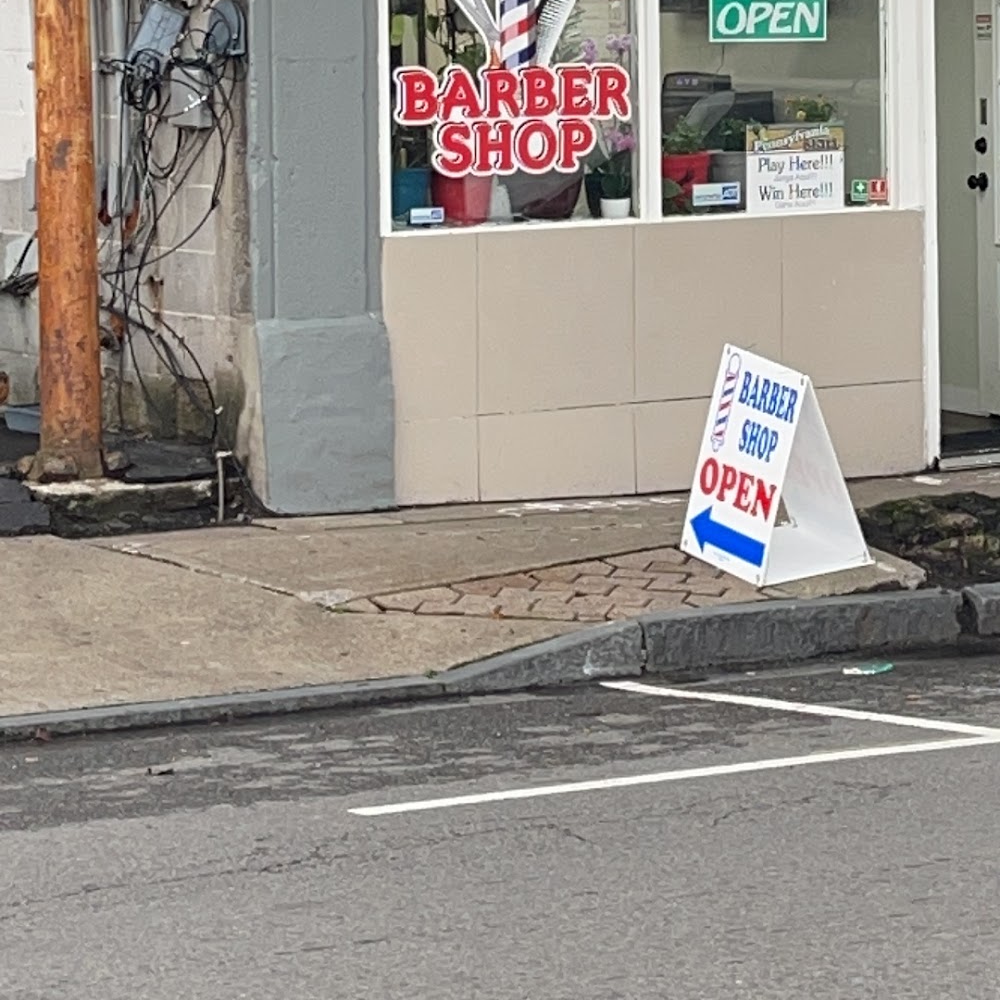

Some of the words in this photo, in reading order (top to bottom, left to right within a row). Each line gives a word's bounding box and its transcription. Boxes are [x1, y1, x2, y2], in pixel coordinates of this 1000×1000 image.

[716, 2, 820, 35] OPEN
[394, 64, 632, 125] BARBER
[431, 116, 597, 178] SHOP
[759, 157, 785, 174] Play
[789, 154, 833, 171] Here!!!
[759, 184, 784, 201] Win
[789, 182, 833, 199] Here!!!
[738, 371, 799, 424] BARBER
[738, 419, 779, 463] SHOP
[699, 457, 777, 523] OPEN
